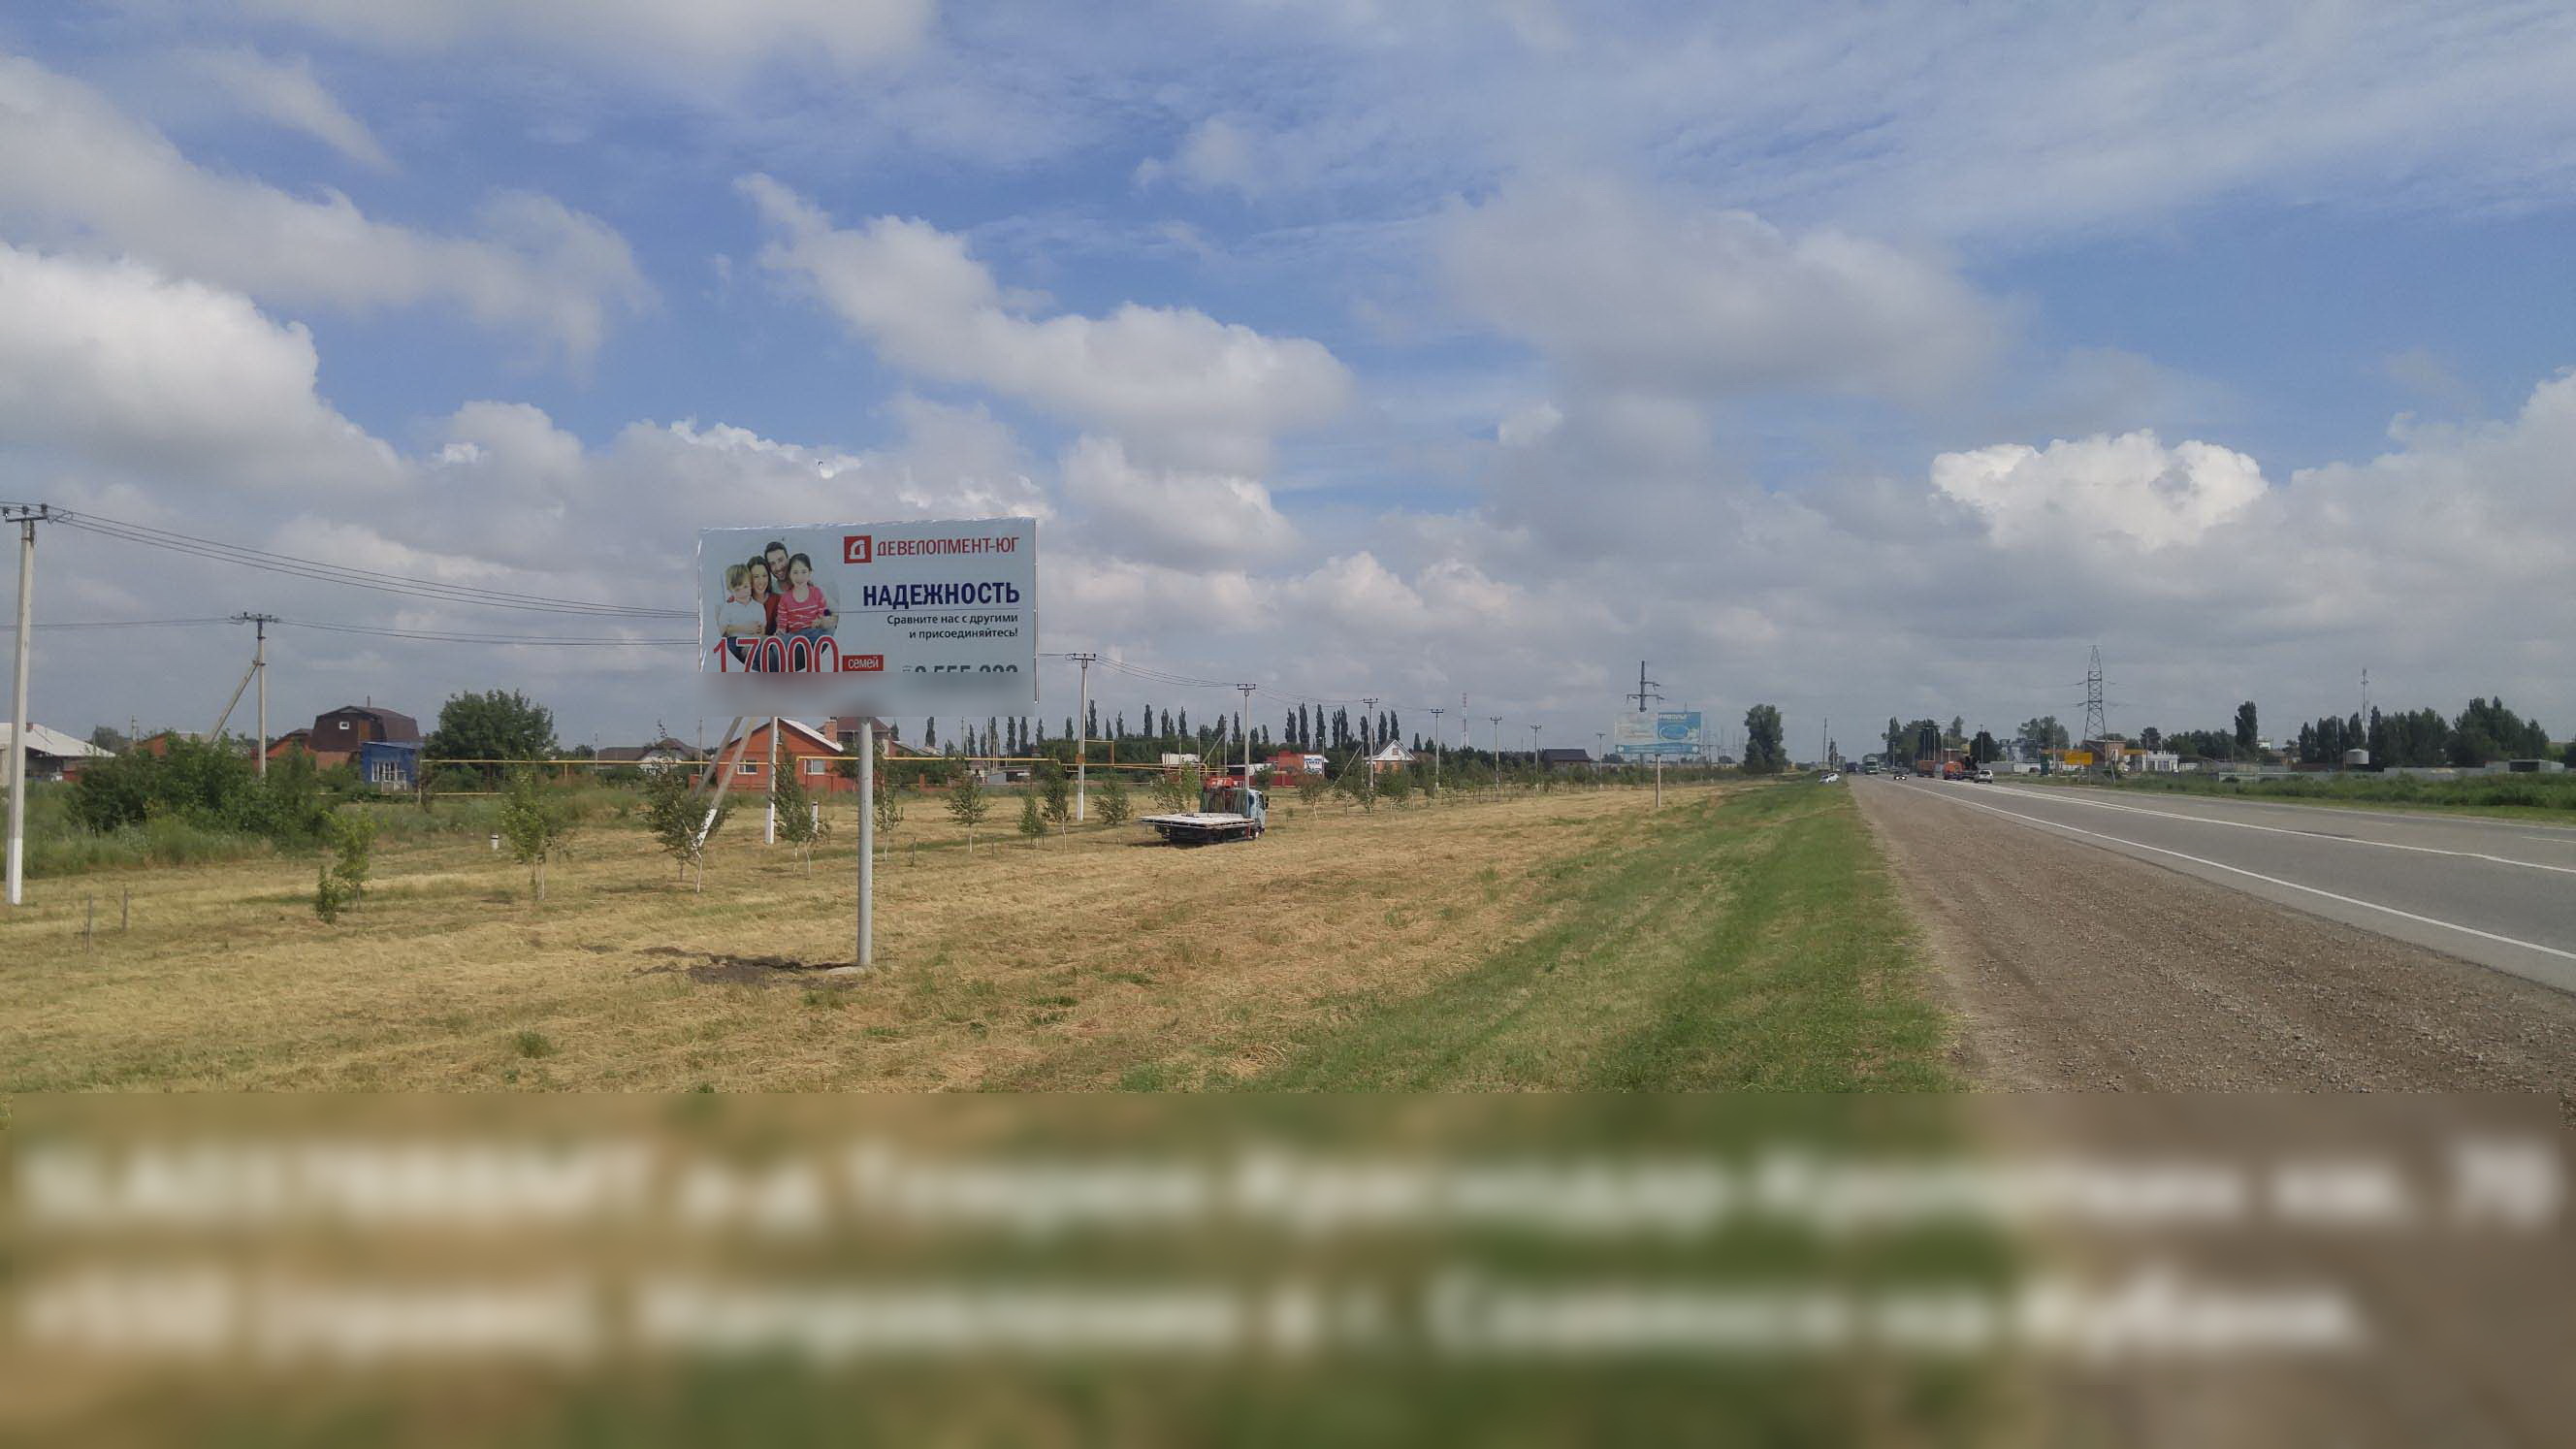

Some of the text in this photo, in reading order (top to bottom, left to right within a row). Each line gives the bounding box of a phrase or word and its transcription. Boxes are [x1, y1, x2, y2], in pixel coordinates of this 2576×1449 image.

[877, 536, 1020, 557] ДЕВЕЛОПМЕНТ-ЮГ
[862, 582, 1020, 610] НАДЕЖНОСТЬ
[886, 613, 1018, 627] Сравните нас с другими
[909, 628, 1018, 642] и присоединяйтесь!
[847, 657, 880, 669] семей
